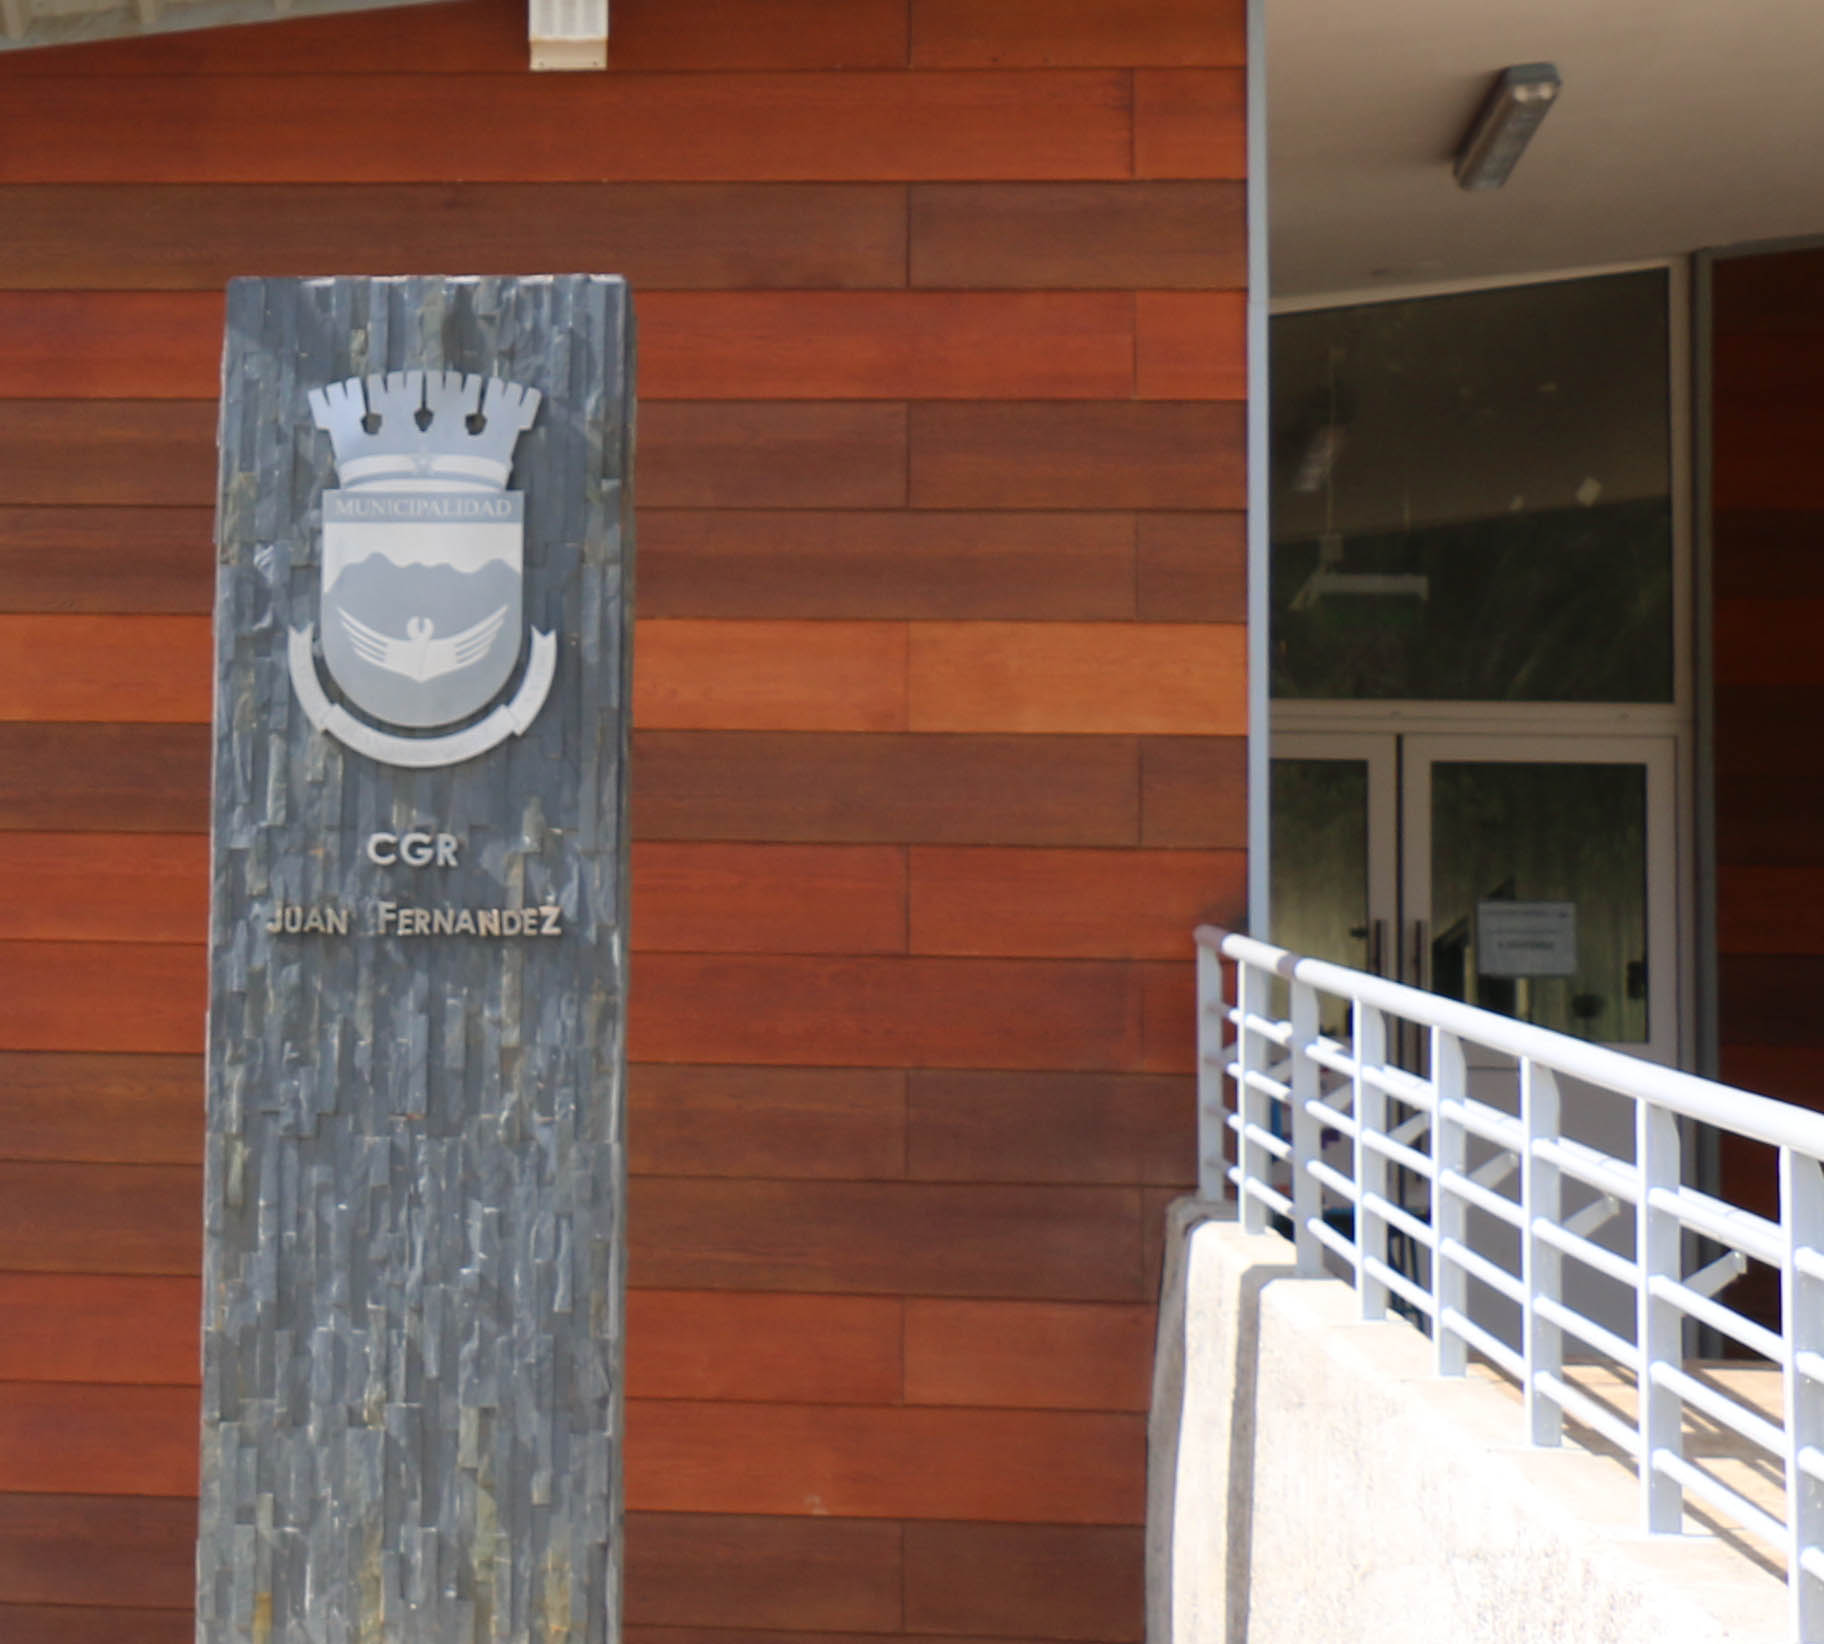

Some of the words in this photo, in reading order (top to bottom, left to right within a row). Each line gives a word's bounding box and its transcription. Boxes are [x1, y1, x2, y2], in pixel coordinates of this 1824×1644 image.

[336, 498, 512, 517] MUNICIPALIDAD
[367, 832, 459, 867] CGR
[266, 902, 348, 934] JUAN
[377, 900, 563, 936] FERNANDEZ
